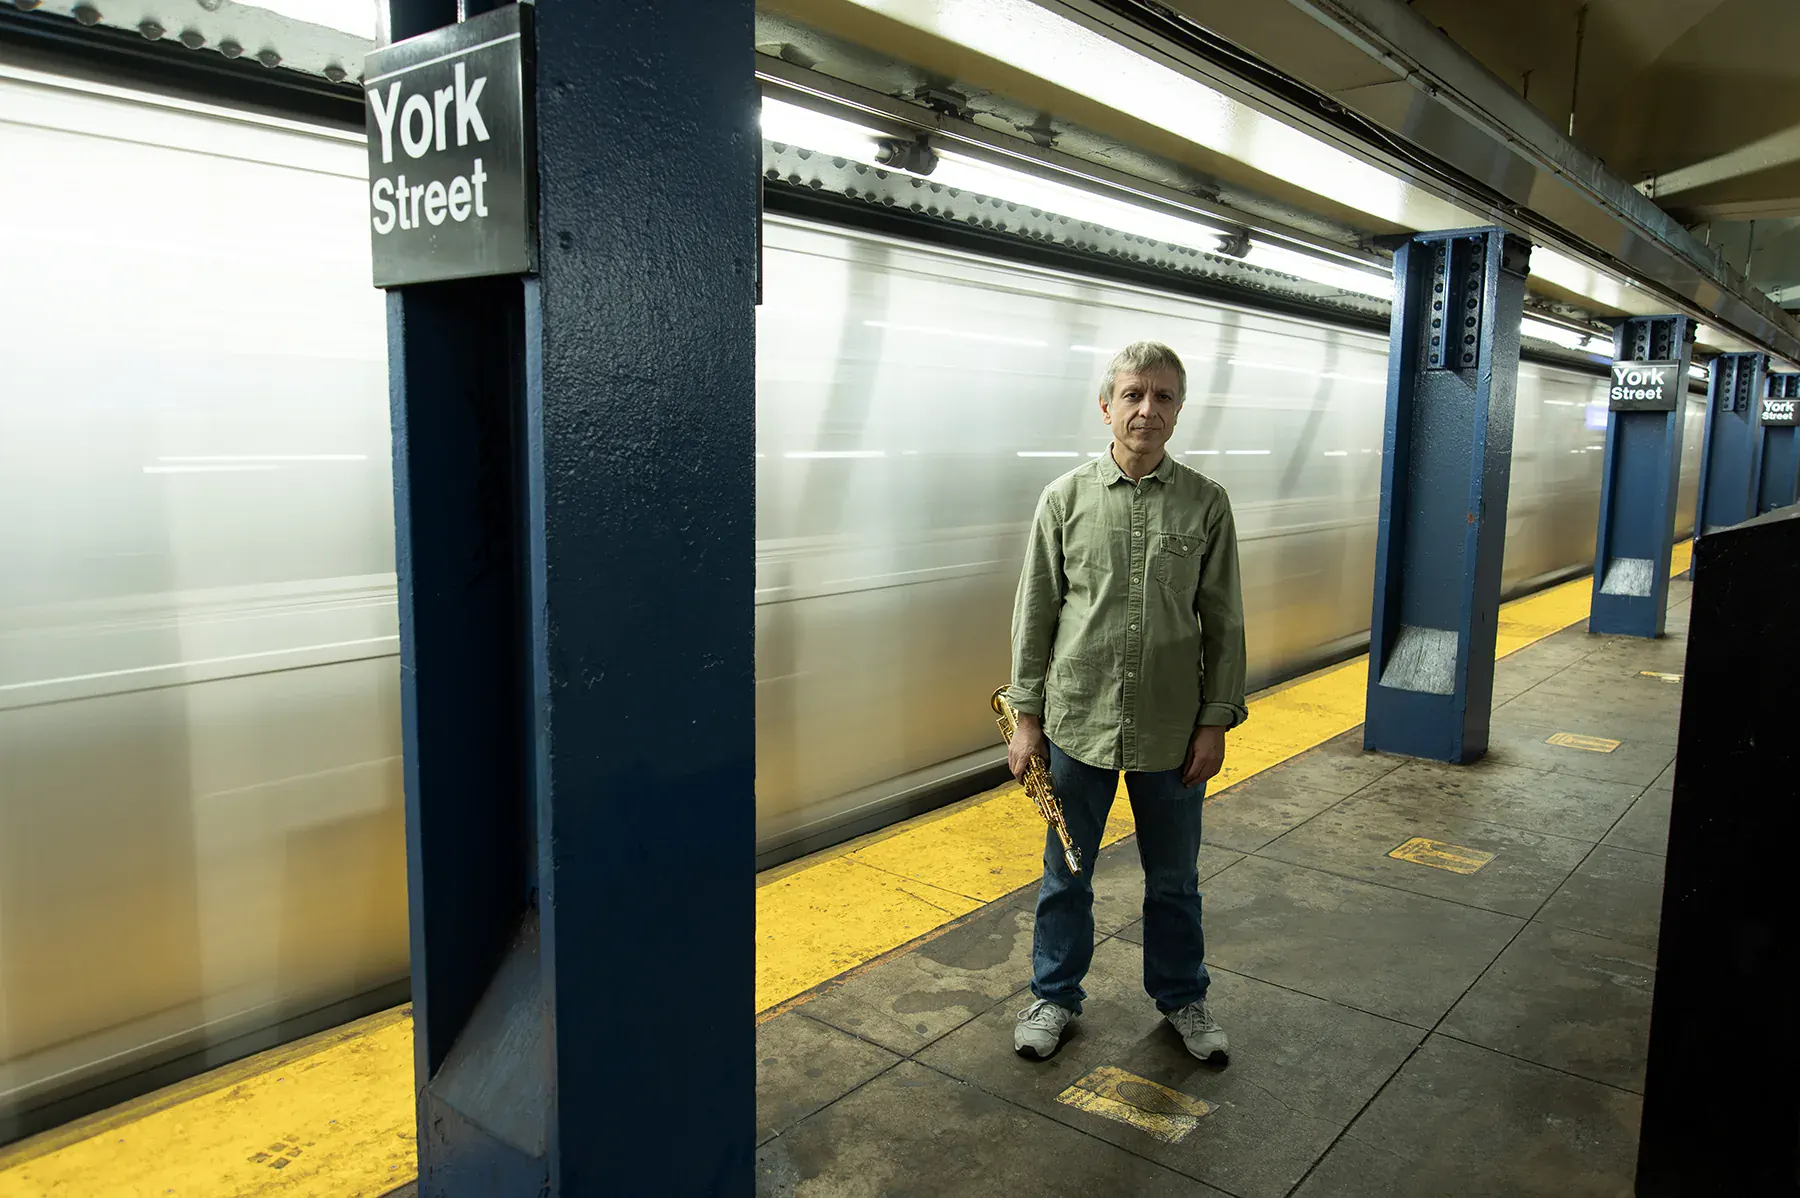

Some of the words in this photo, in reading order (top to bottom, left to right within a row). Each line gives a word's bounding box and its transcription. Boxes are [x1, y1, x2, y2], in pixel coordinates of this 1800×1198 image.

[368, 62, 490, 164] York
[372, 158, 488, 235] Street
[1613, 368, 1665, 385] York
[1611, 387, 1662, 400] Street
[1763, 401, 1794, 412] York
[1762, 411, 1793, 421] Street
